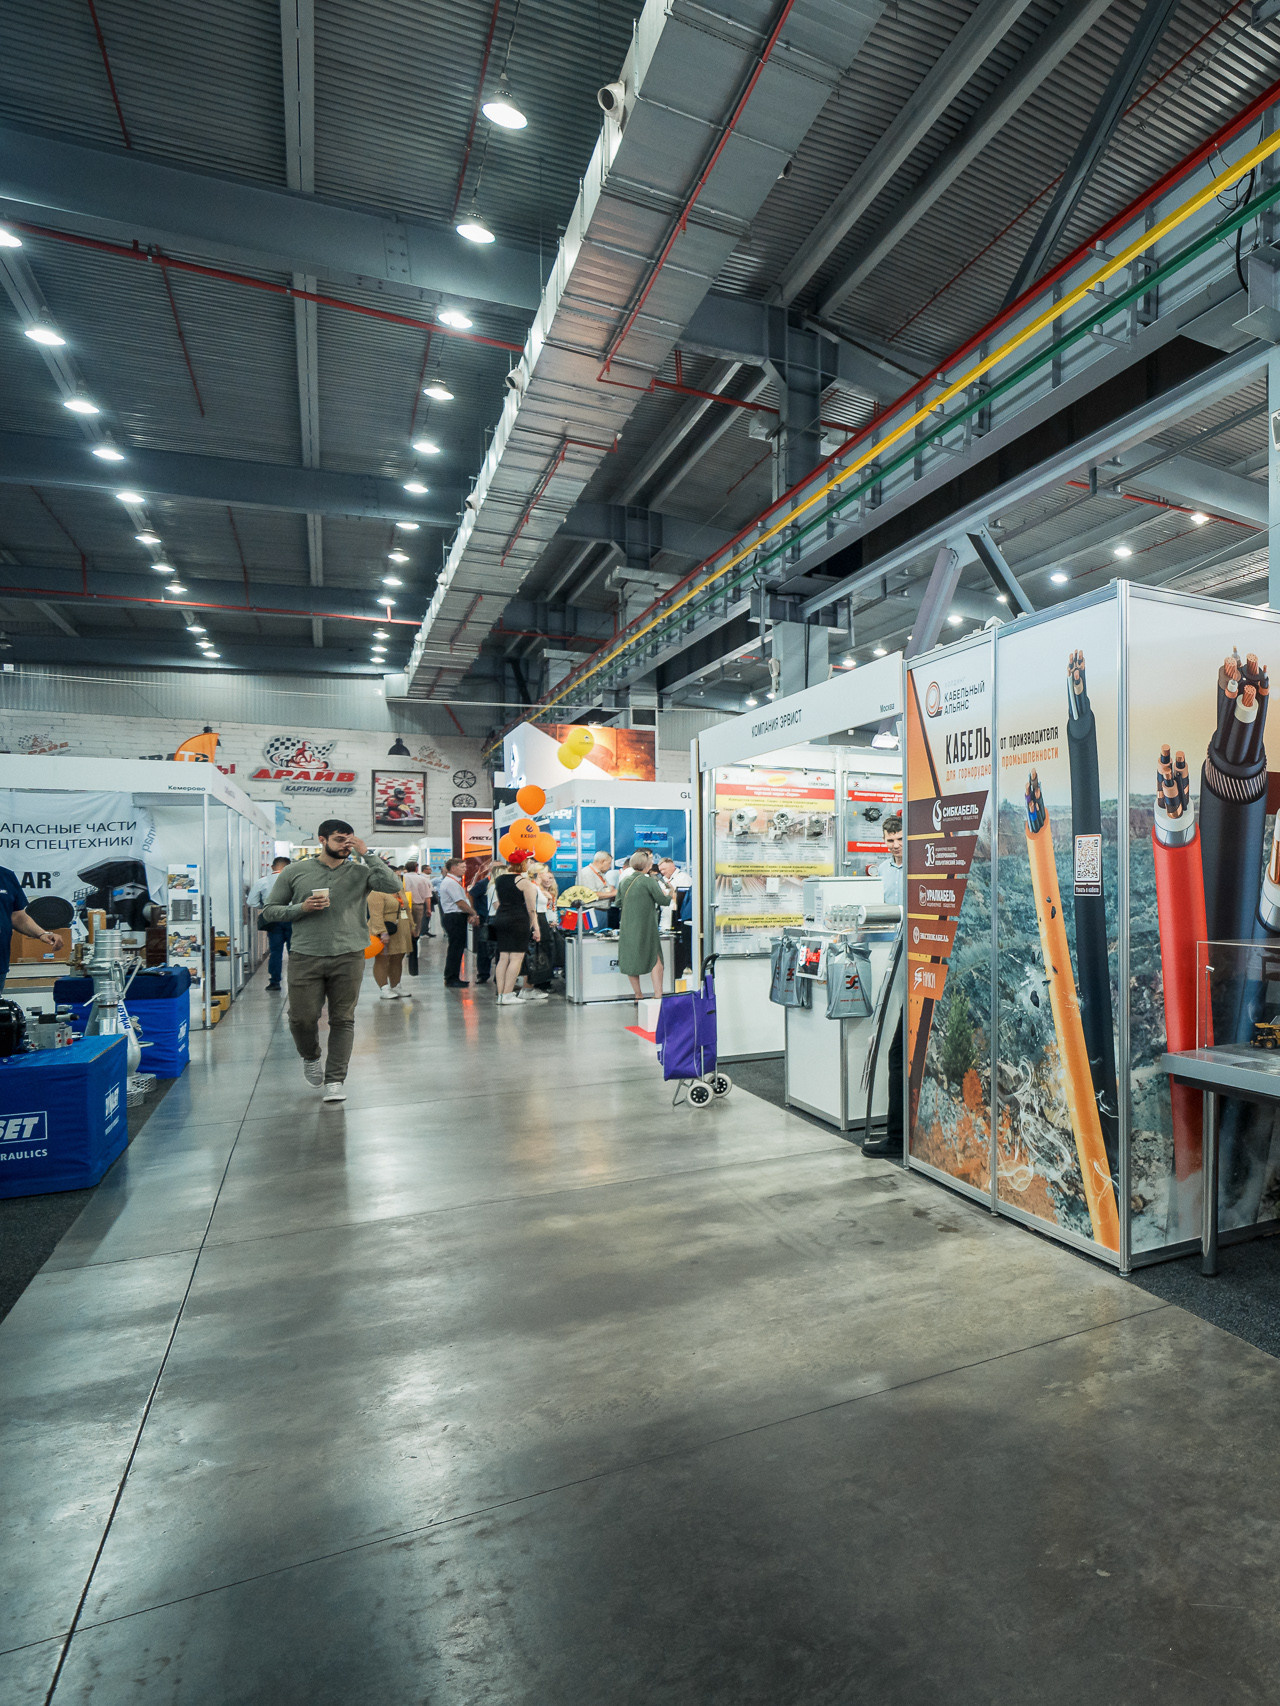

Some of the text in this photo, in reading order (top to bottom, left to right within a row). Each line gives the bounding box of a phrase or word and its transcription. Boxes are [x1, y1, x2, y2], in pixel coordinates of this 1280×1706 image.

[944, 680, 985, 703] КАБЕЛЬНЫЙ
[880, 703, 895, 713] Москва
[944, 699, 970, 716] АЛЬЯНС
[751, 709, 802, 738] КОМПАНИЯ ЭРВИСТ
[945, 726, 1059, 765] КАБЕЛЬ от производителя
[1001, 747, 1059, 769] промышленности
[252, 768, 356, 783] ДРАЙВ
[284, 785, 354, 794] КАРТИНГ-ЦЕНТР
[942, 804, 979, 818] СИБКАБЕЛЬ
[86, 821, 138, 834] ЧАСТИ
[0, 1149, 48, 1161] RAULICS
